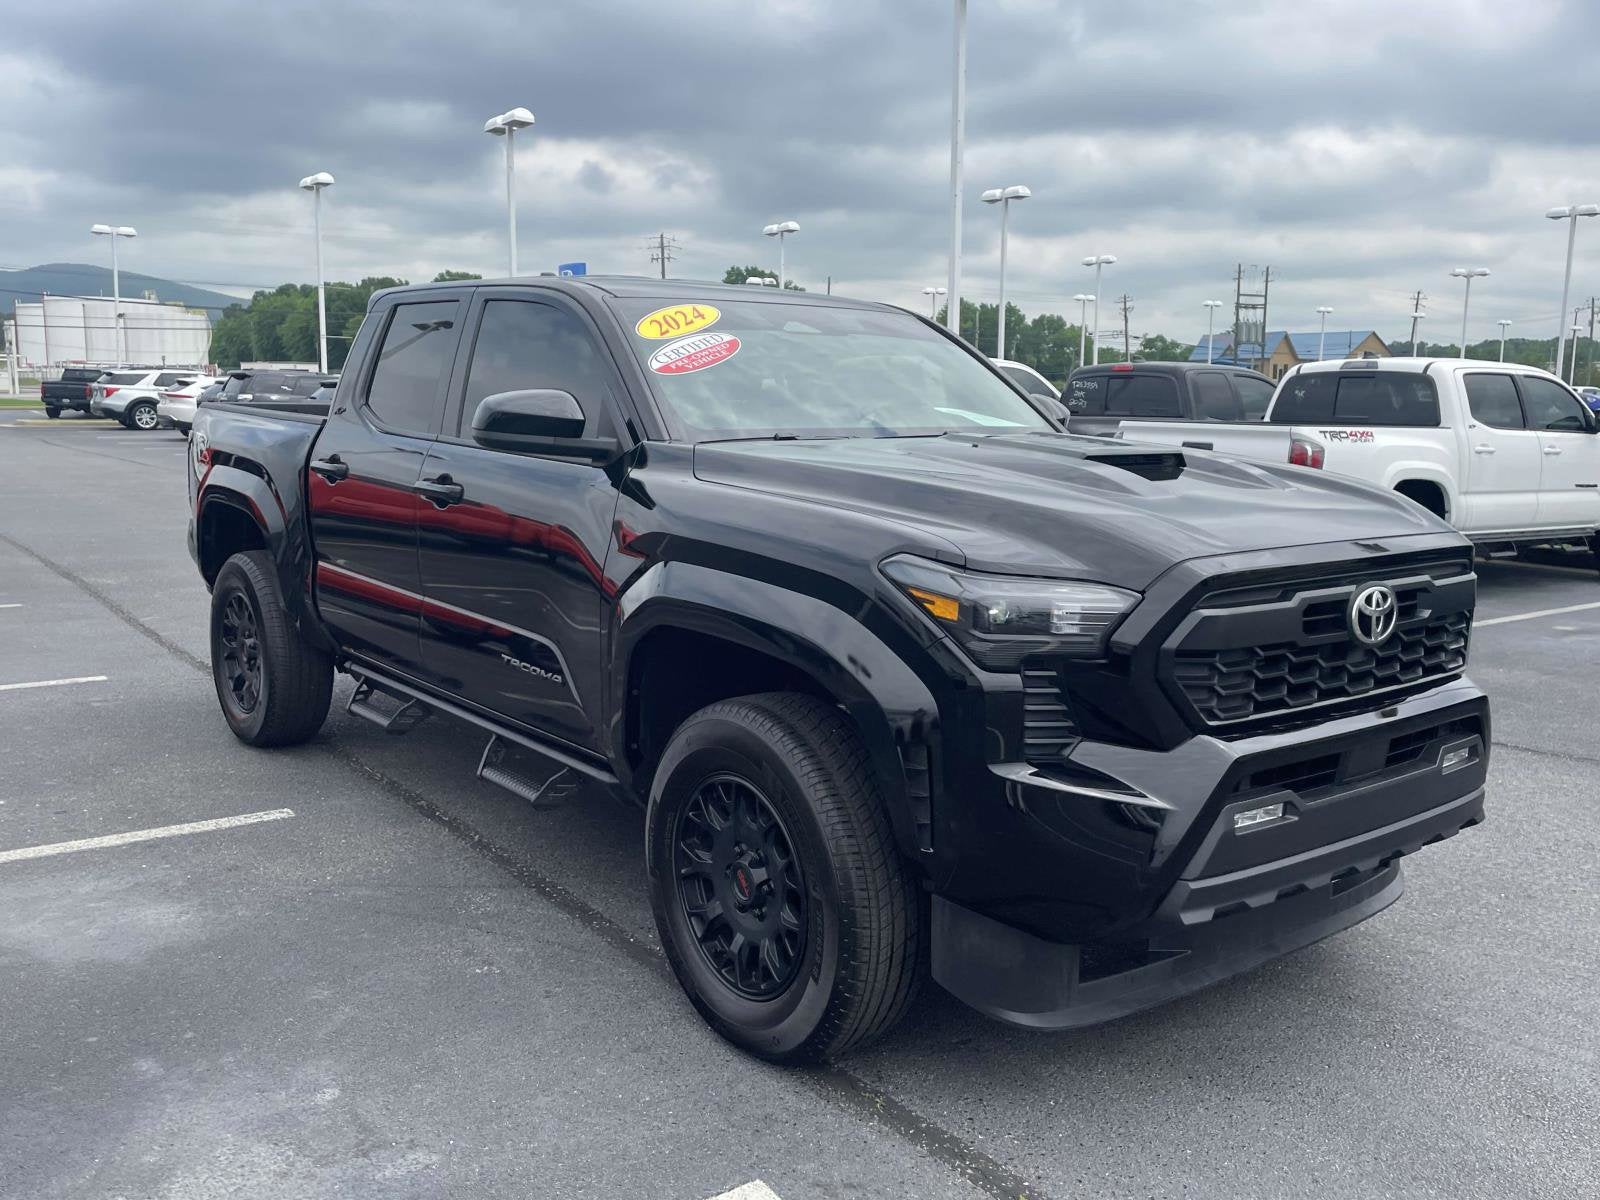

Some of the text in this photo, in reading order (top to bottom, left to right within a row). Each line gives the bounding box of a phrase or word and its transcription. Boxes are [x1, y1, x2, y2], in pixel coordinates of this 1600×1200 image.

[650, 306, 706, 336] 2024
[655, 333, 724, 364] CERTIFIED
[669, 342, 730, 370] PRE-OWNED
[684, 349, 731, 371] VEHICLE
[501, 653, 562, 683] TACOMA
